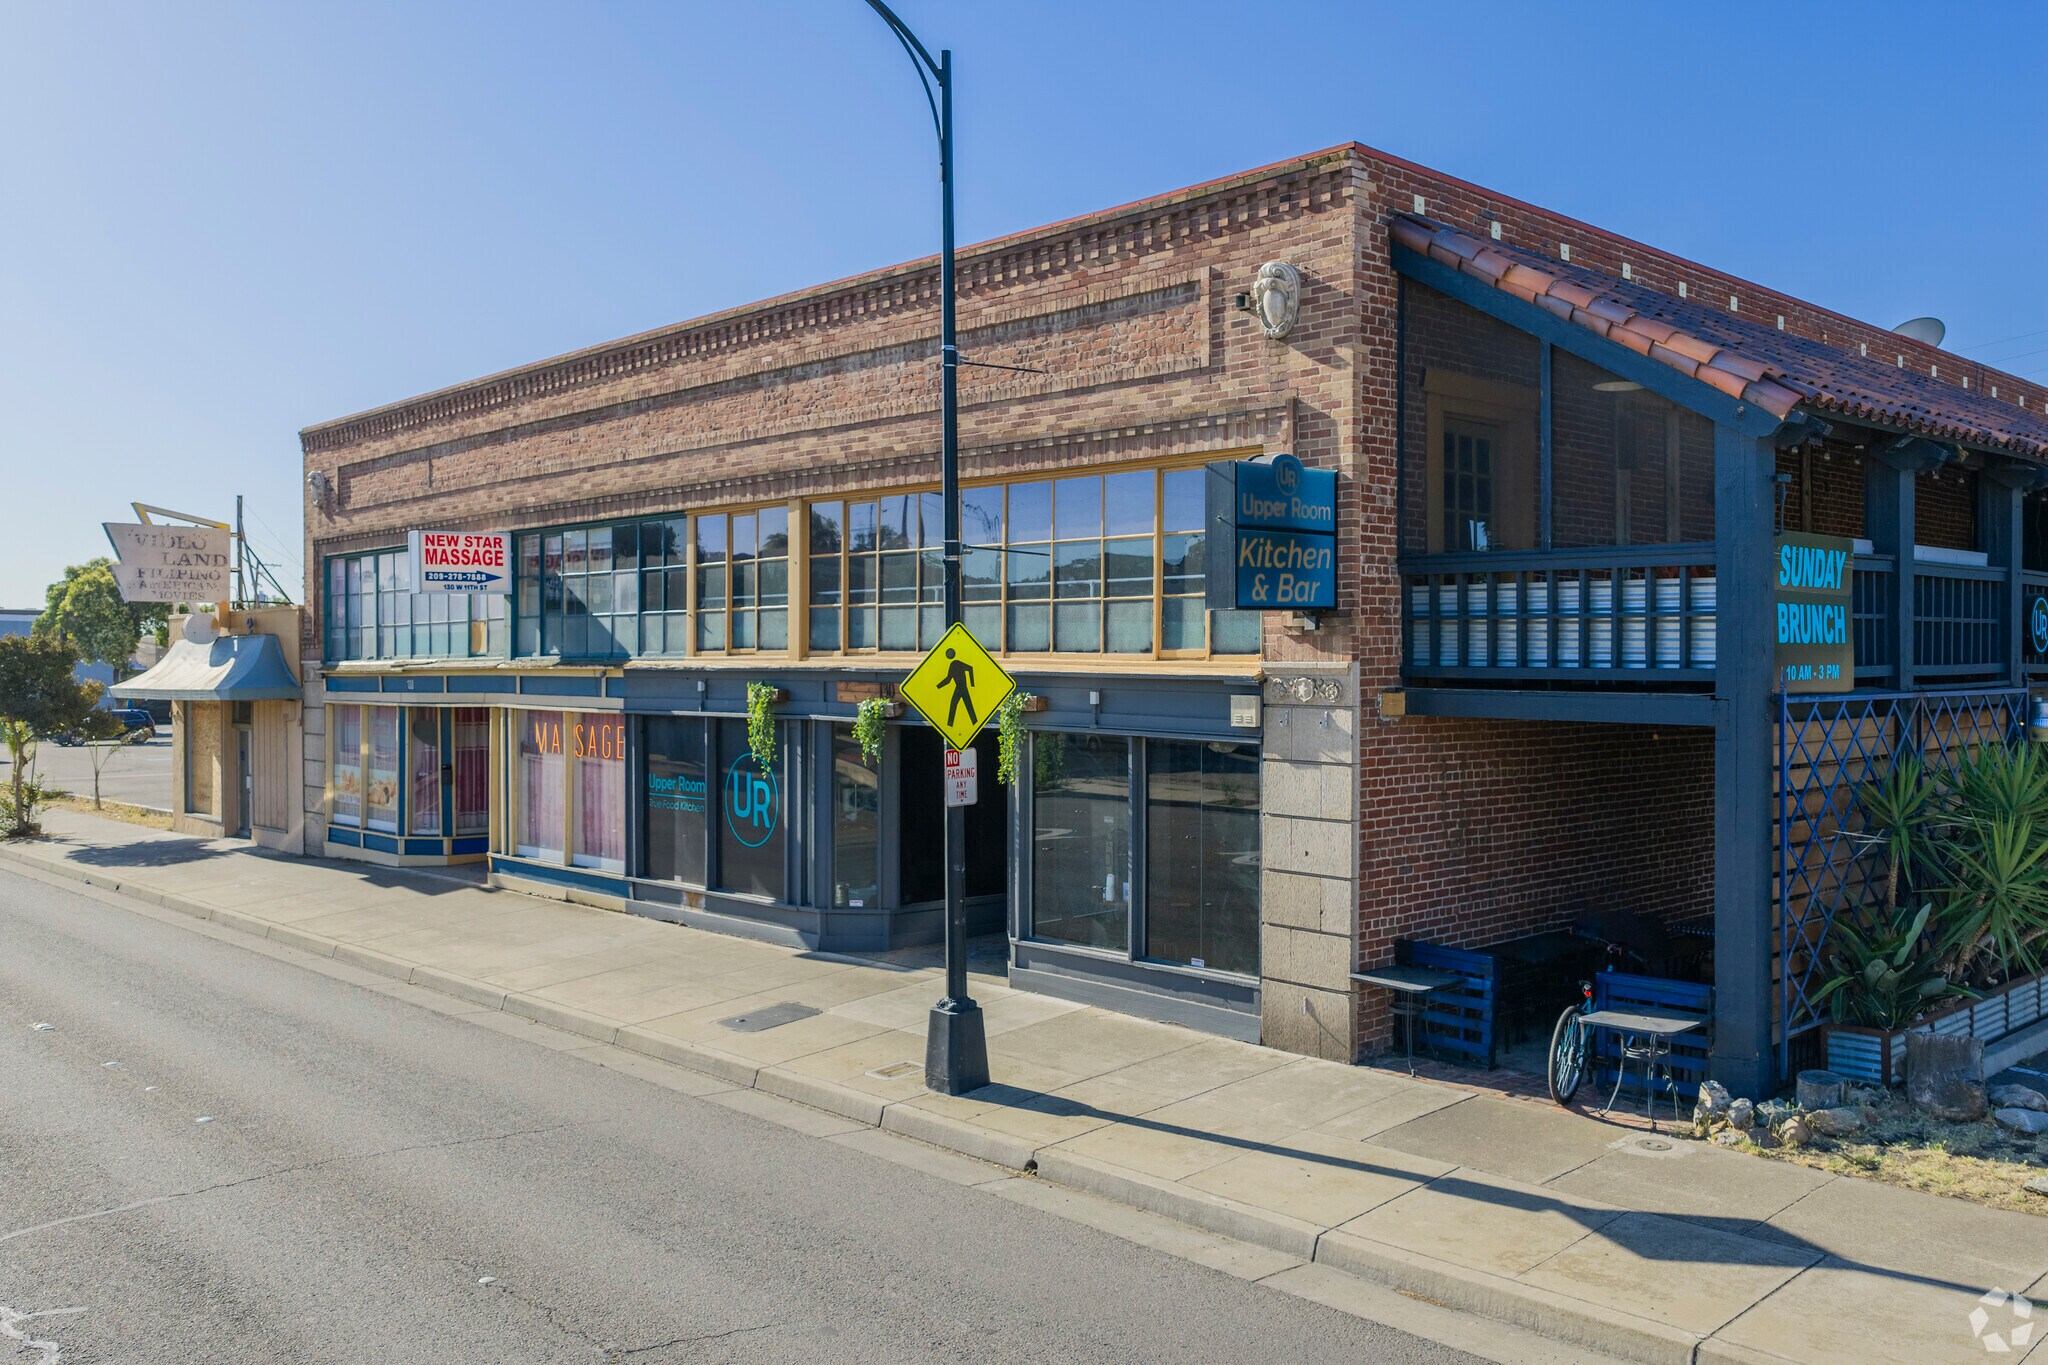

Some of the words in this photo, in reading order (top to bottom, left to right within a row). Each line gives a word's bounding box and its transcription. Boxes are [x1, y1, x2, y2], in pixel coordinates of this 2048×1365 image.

[1279, 464, 1296, 487] UR
[1242, 493, 1287, 521] Upper
[1291, 497, 1331, 521] Room
[425, 534, 459, 547] NEW
[464, 535, 502, 549] STAR
[161, 552, 228, 567] LAND
[425, 548, 504, 567] MASSAGE
[1239, 537, 1331, 570] Kitchen
[137, 567, 221, 580] FILIPINO
[1779, 543, 1847, 590] SUNDAY
[428, 573, 487, 581] 209-278-7888
[1251, 573, 1269, 602] &
[1277, 573, 1320, 603] Bar
[1777, 602, 1847, 645] BRUNCH
[2035, 609, 2048, 640] UR
[1786, 665, 1797, 681] 10
[1798, 665, 1812, 681] AM
[1818, 665, 1824, 680] 3
[1826, 664, 1840, 680] PM
[535, 722, 624, 760] MASAGE
[947, 752, 958, 765] NO
[948, 767, 975, 779] PARKING
[649, 773, 676, 792] Upper
[678, 775, 706, 794] Room
[956, 780, 967, 789] ANY
[733, 770, 771, 829] UR
[956, 790, 967, 799] TIME
[663, 800, 679, 810] Food
[680, 801, 704, 813] Kitchen
